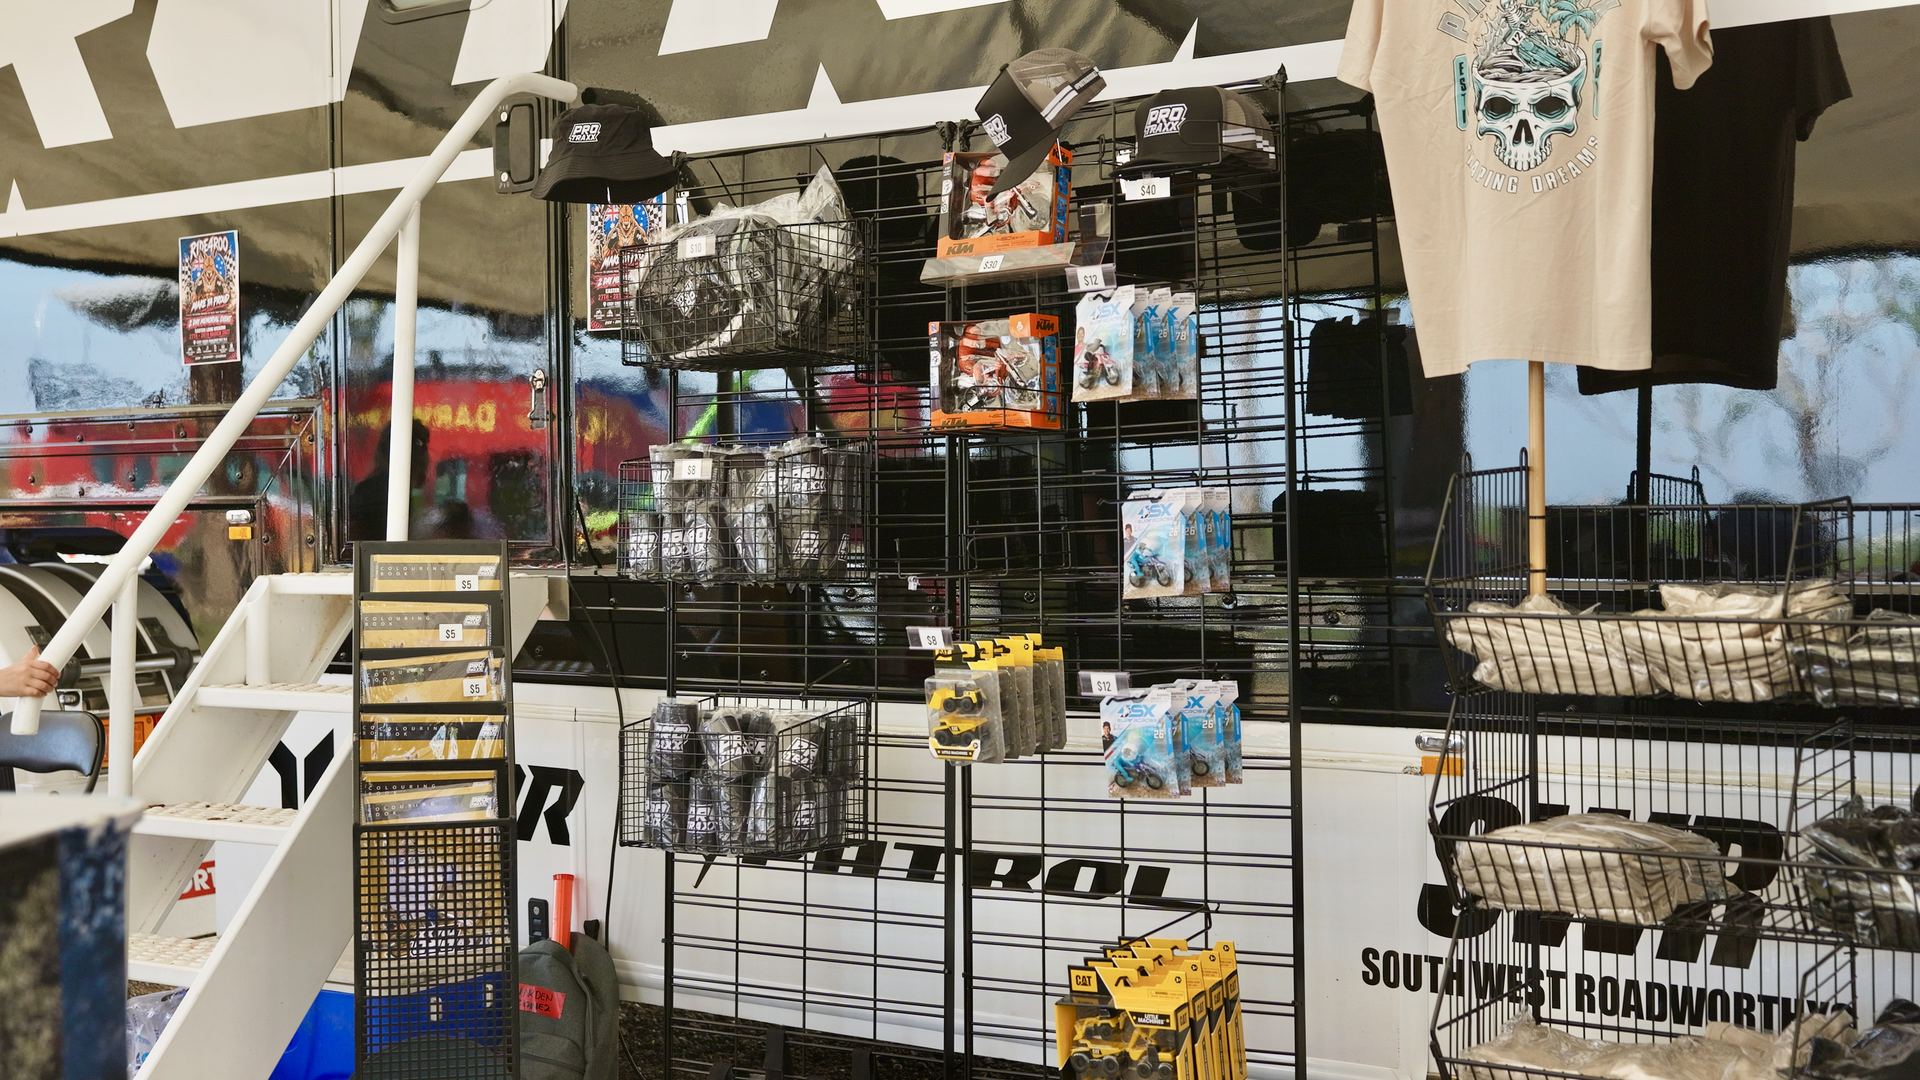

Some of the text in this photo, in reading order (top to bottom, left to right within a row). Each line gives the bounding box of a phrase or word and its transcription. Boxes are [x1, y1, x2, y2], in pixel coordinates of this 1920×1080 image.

[1149, 106, 1184, 125] PRO
[573, 124, 600, 135] PRO
[1145, 120, 1179, 135] TRAXX
[1531, 135, 1600, 194] DREAMS
[1140, 184, 1156, 197] $40
[689, 242, 702, 255] $10
[946, 242, 974, 255] KTM
[983, 260, 998, 270] $30
[1083, 274, 1099, 287] $12
[1035, 318, 1055, 332] KTM
[687, 464, 696, 476] $8
[461, 580, 472, 590] $5
[445, 629, 456, 639] $5
[926, 635, 938, 647] $8
[469, 684, 481, 695] $5
[1097, 681, 1112, 692] $12
[1202, 719, 1214, 729] 26
[1153, 729, 1165, 740] 26
[368, 783, 436, 791] COLOURING
[1075, 974, 1092, 987] CAT
[1361, 946, 1463, 997] SOUTH
[1470, 959, 1567, 1011] WEST
